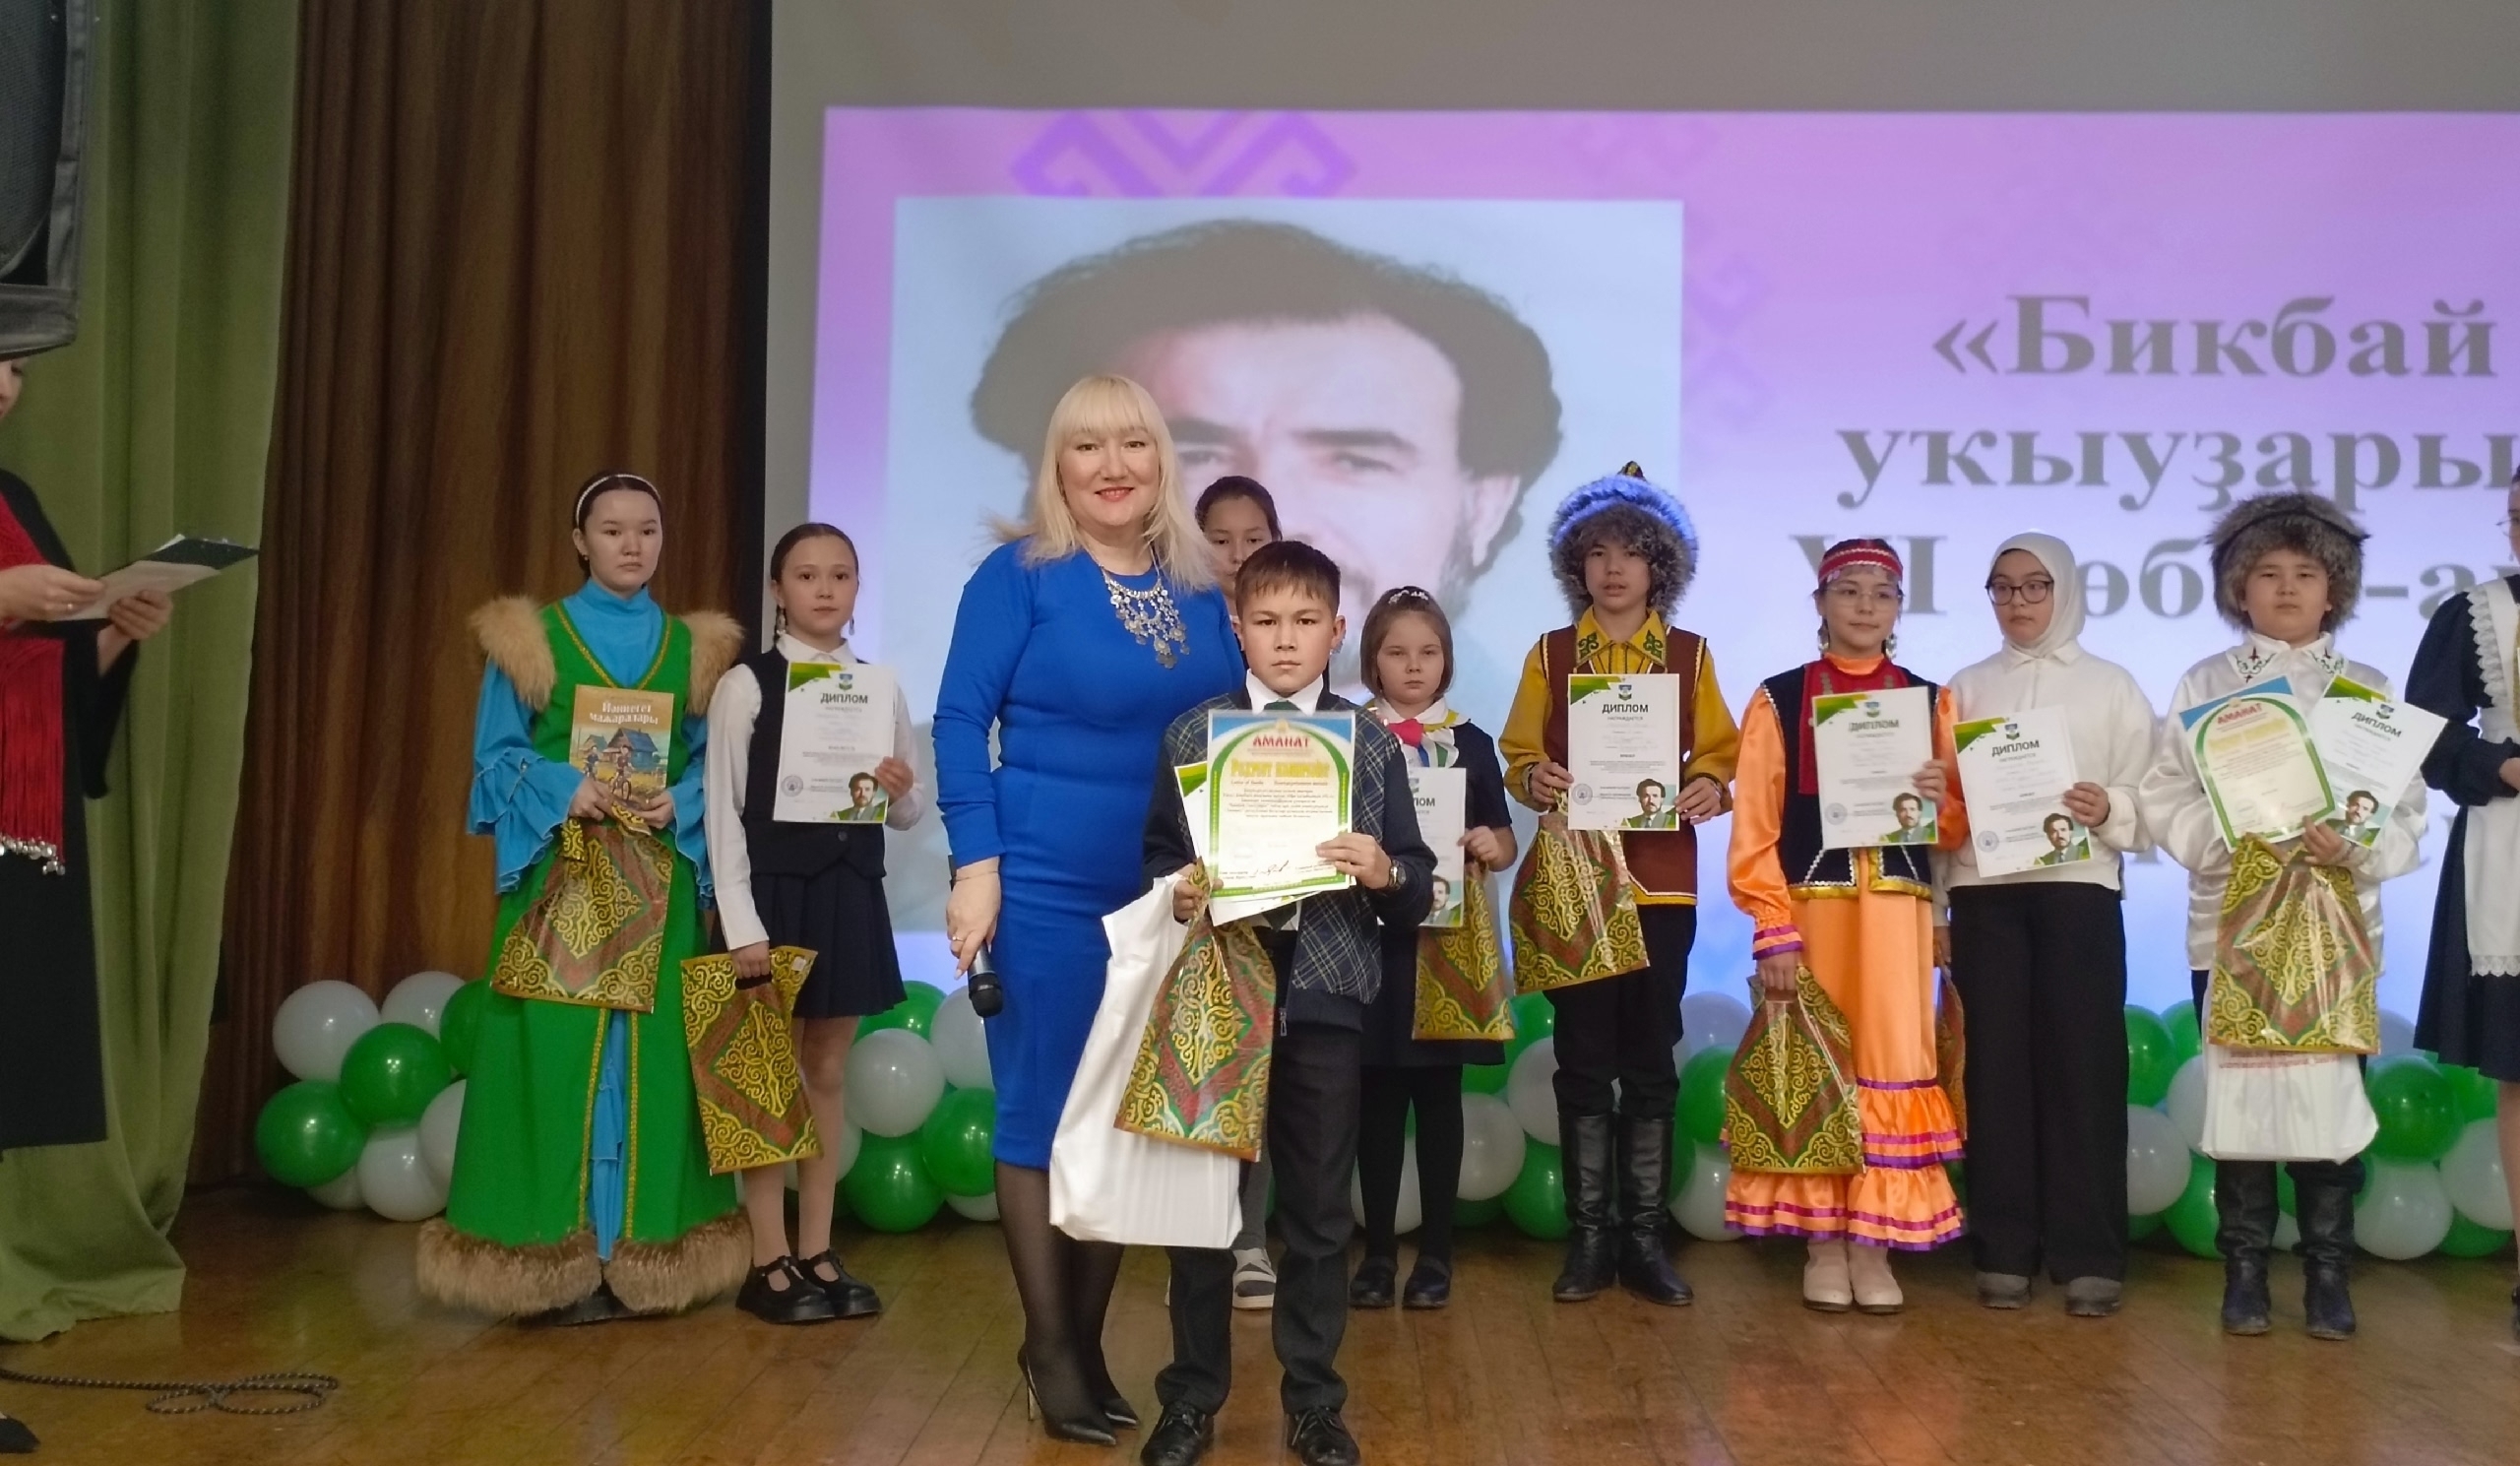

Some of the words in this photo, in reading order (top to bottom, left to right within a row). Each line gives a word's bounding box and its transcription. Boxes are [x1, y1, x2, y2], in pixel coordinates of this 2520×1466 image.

[1931, 294, 2499, 378] «Бикбай
[820, 692, 868, 704] ДИПЛОМ
[1602, 704, 1649, 714] ДИПЛОМ
[2351, 712, 2402, 737] ДИПЛОМ
[1253, 735, 1310, 747] АМАНАТ
[1991, 739, 2040, 757] ДИПЛОМ
[1415, 797, 1435, 806] ЛОМ
